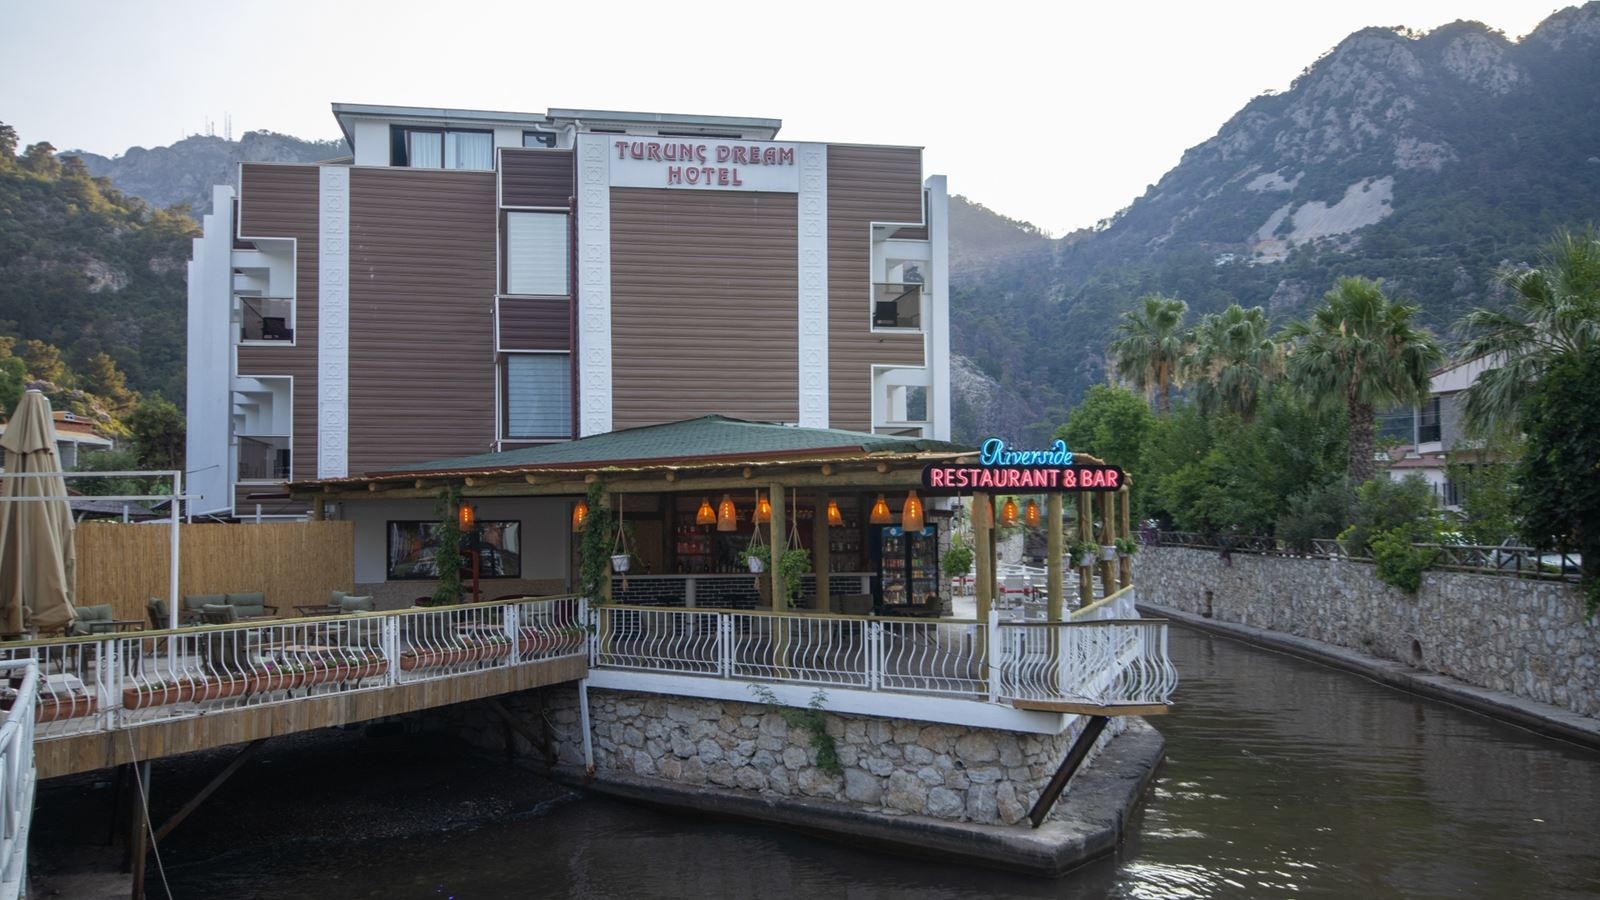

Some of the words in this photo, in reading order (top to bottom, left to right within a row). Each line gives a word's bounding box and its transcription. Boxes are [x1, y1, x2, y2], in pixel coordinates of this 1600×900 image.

[615, 141, 707, 164] TURUNÇ
[716, 144, 795, 166] DREAM
[667, 166, 743, 186] HOTEL
[980, 437, 1074, 466] Riverside
[930, 468, 1060, 488] RESTAURANT
[1063, 470, 1077, 488] &
[1080, 469, 1119, 488] BAR
